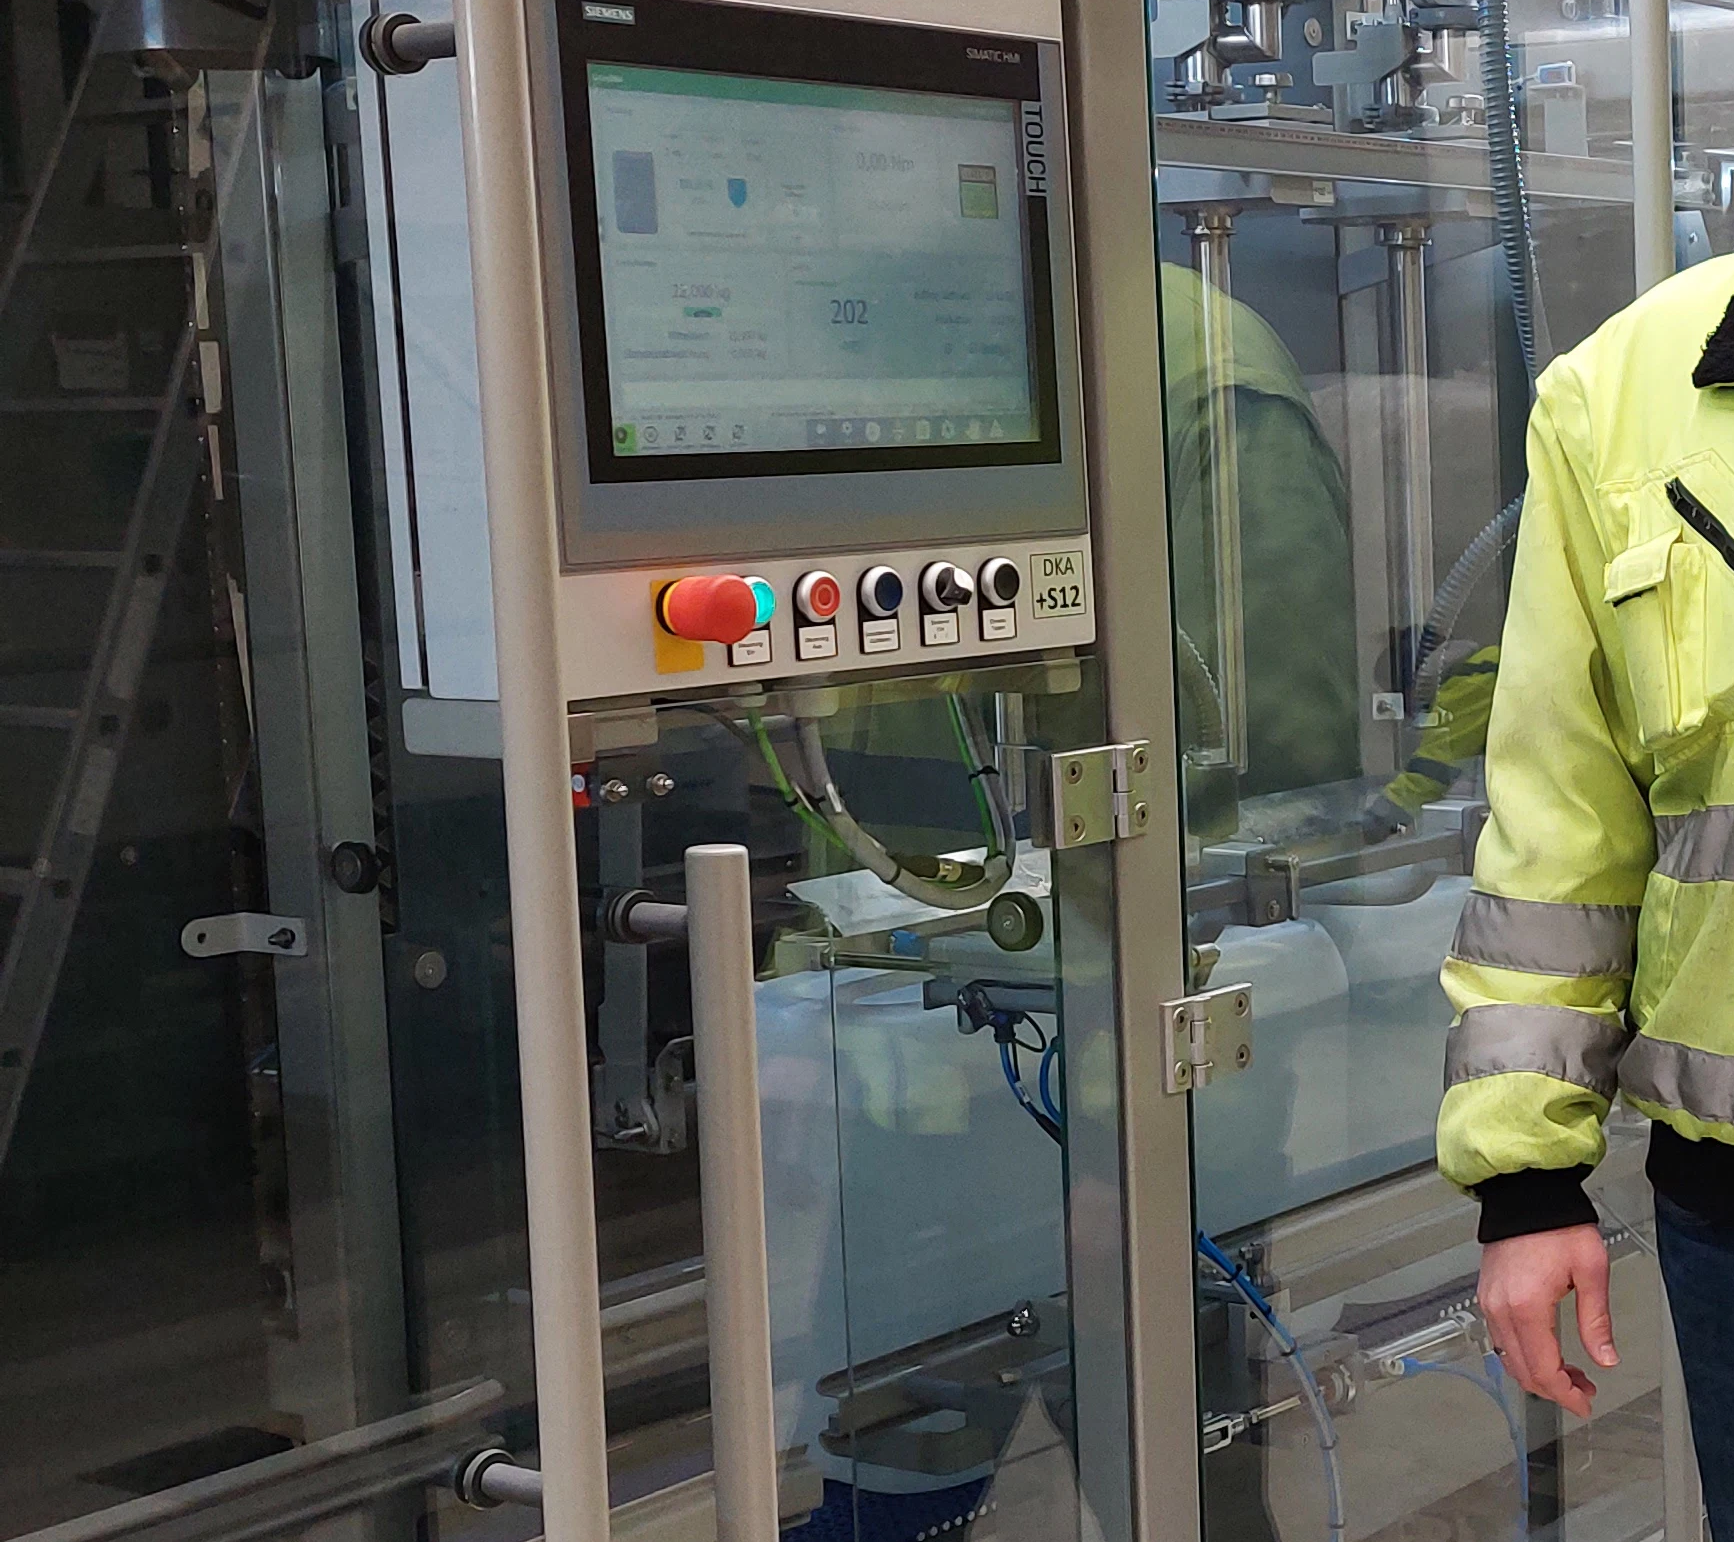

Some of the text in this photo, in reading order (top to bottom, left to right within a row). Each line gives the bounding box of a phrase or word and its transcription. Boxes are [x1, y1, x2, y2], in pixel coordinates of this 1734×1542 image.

[584, 5, 634, 21] SIEMENS
[966, 47, 1002, 63] SIMATIC
[1023, 104, 1047, 194] TOUCH
[829, 298, 869, 325] 202
[1043, 556, 1075, 577] DKA
[1035, 584, 1082, 611] +S12
